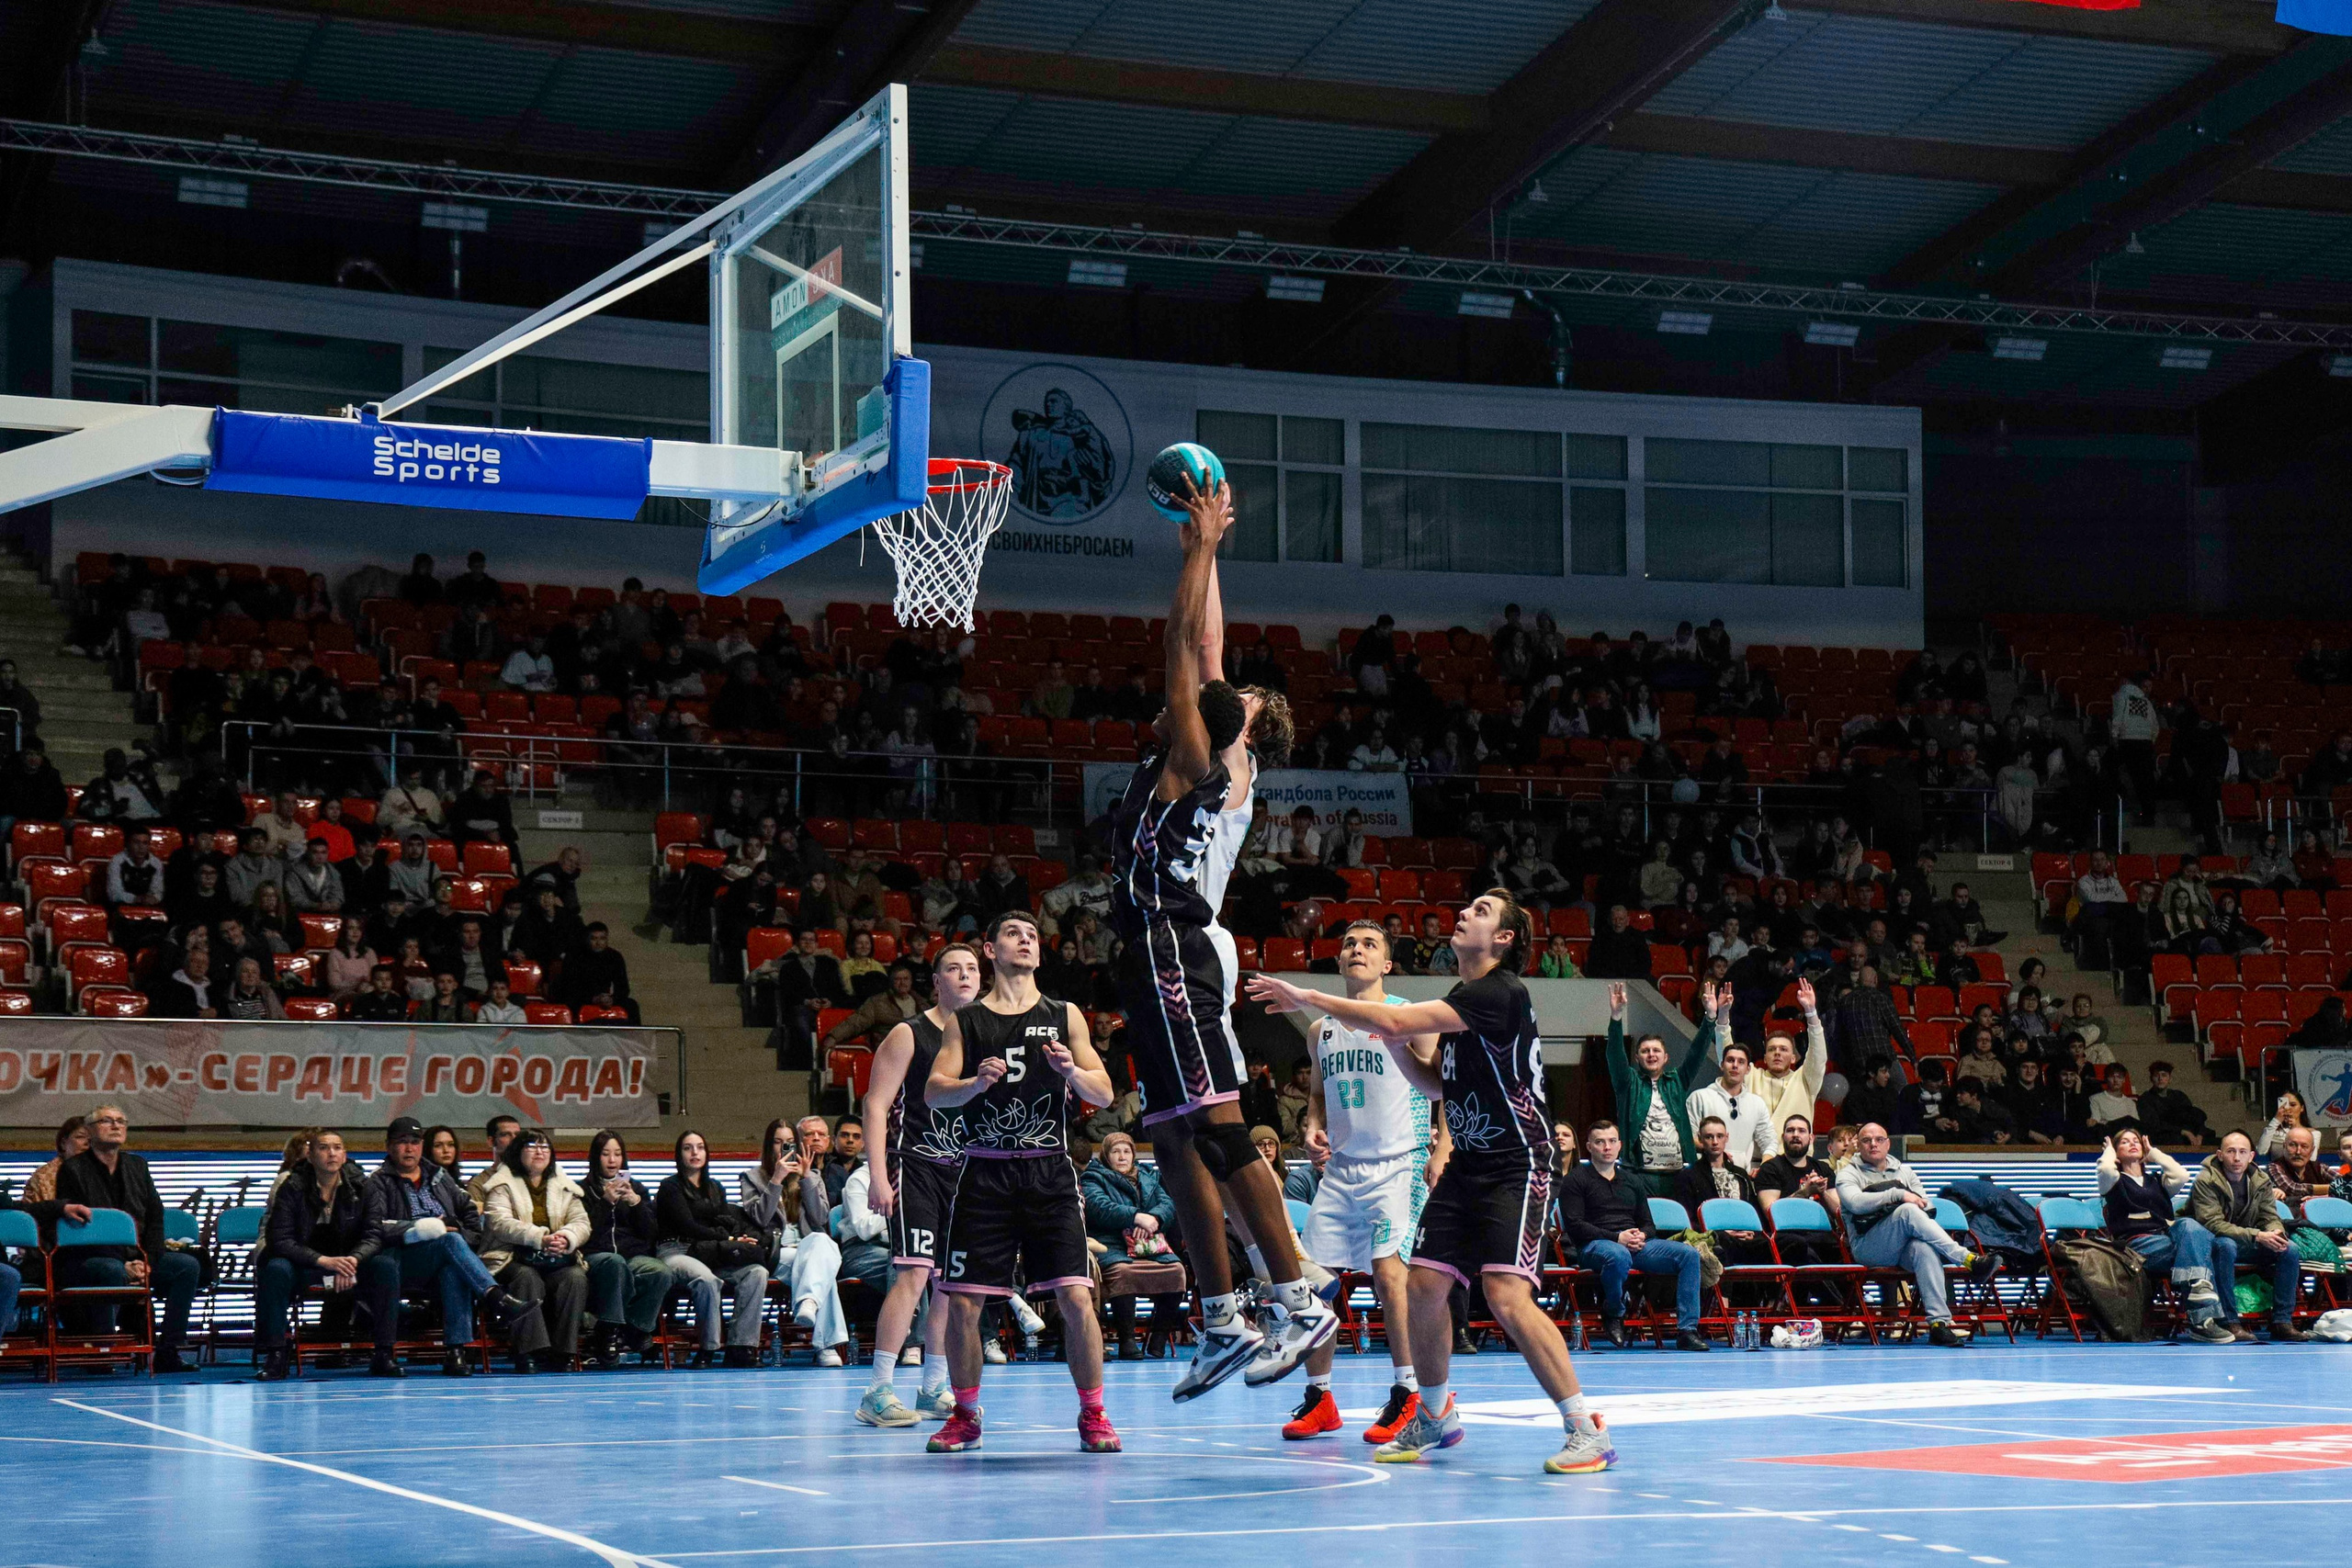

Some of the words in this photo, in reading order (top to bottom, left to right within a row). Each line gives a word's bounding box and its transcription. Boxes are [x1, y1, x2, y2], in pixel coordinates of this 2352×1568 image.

[374, 435, 501, 465] Schelde
[374, 457, 501, 484] Sports
[988, 530, 1134, 558] СВОИХНЕБРОСАЕМ
[1258, 784, 1333, 804] гандбола
[1337, 784, 1396, 801] России
[1353, 808, 1398, 826] ussia
[1005, 1044, 1027, 1084] 5
[1321, 1049, 1384, 1081] BEAVERS
[1442, 1042, 1457, 1081] 84
[423, 1055, 645, 1104] ГОРОДА!
[1337, 1077, 1365, 1110] 23
[910, 1227, 934, 1256] 12
[949, 1250, 967, 1278] 5
[1206, 1311, 1229, 1319] adidas
